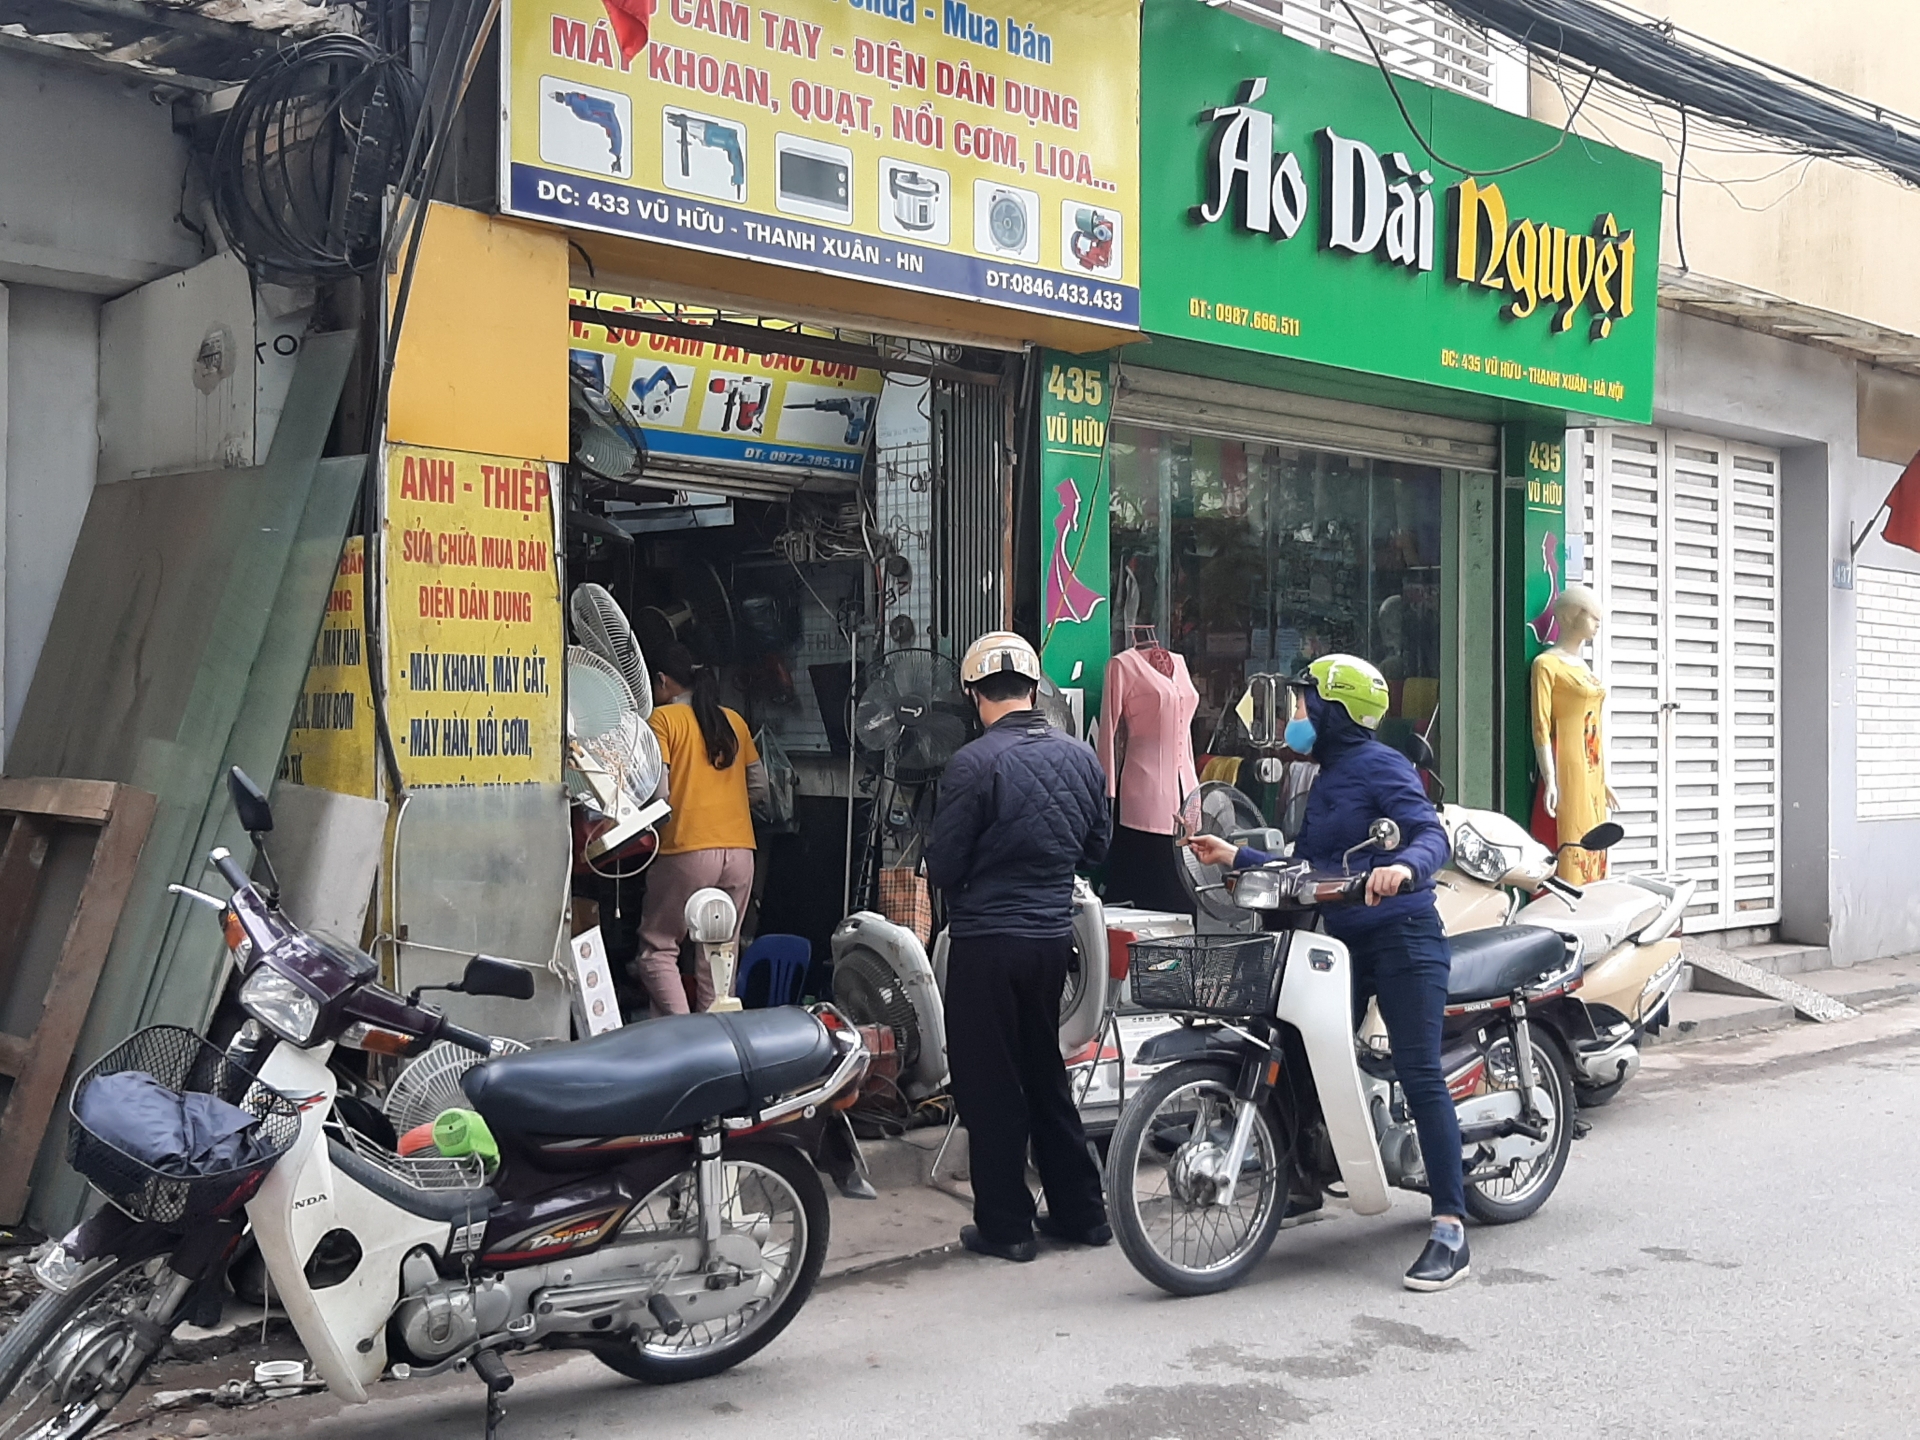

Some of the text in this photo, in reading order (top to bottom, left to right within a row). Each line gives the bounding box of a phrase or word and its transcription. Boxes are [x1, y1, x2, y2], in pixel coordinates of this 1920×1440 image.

[943, 1, 999, 49] Mua
[1006, 18, 1051, 64] bán
[761, 11, 822, 60] TAY
[854, 38, 925, 89] ĐIỆN
[936, 61, 995, 107] DÂN
[1005, 80, 1078, 130] DỤNG
[648, 42, 779, 113] KHOAN,
[791, 80, 881, 138] QUẠT,
[893, 103, 943, 149] NỒI
[954, 123, 1025, 173] CƠM,
[1035, 142, 1116, 191] LIOA...
[538, 179, 579, 206] ĐC:
[587, 192, 629, 215] 433
[637, 199, 669, 223] VŨ
[677, 207, 723, 233] HỮU
[743, 221, 816, 251] THANH
[822, 236, 879, 264] XUÂN
[896, 253, 923, 273] HN
[1199, 77, 1636, 339] Áo Dài Nguyệt
[986, 270, 1122, 311] ĐT:0846.433.433
[1215, 303, 1300, 337] 0987.666.511
[1048, 364, 1102, 406] 435
[1461, 354, 1481, 372] 435
[1484, 356, 1498, 375] VŨ
[1500, 360, 1521, 380] HỮU
[1528, 366, 1560, 388] THANH
[1562, 373, 1588, 393] XUÂN
[1594, 378, 1606, 397] HÀ
[1608, 381, 1625, 402] NỘI
[1046, 412, 1105, 447] VŨ HỮU
[1529, 440, 1561, 473] 435
[400, 456, 454, 505] ANH
[480, 461, 550, 521] THIỆP
[1528, 477, 1562, 506] VŨ HỮU
[403, 516, 547, 572] SỬA CHỮA MUA BÁN
[418, 579, 531, 628] ĐIỆN DÂN DỤNG
[410, 645, 439, 691] MÁY
[443, 653, 490, 697] KHOAN,
[493, 647, 519, 693] MÁY
[523, 644, 549, 698] CẮT,
[410, 710, 439, 757] MÁY
[443, 710, 473, 761] HÀN,
[477, 705, 498, 756] NỒI
[502, 716, 533, 760] CƠM,
[639, 1131, 684, 1143] HONDA
